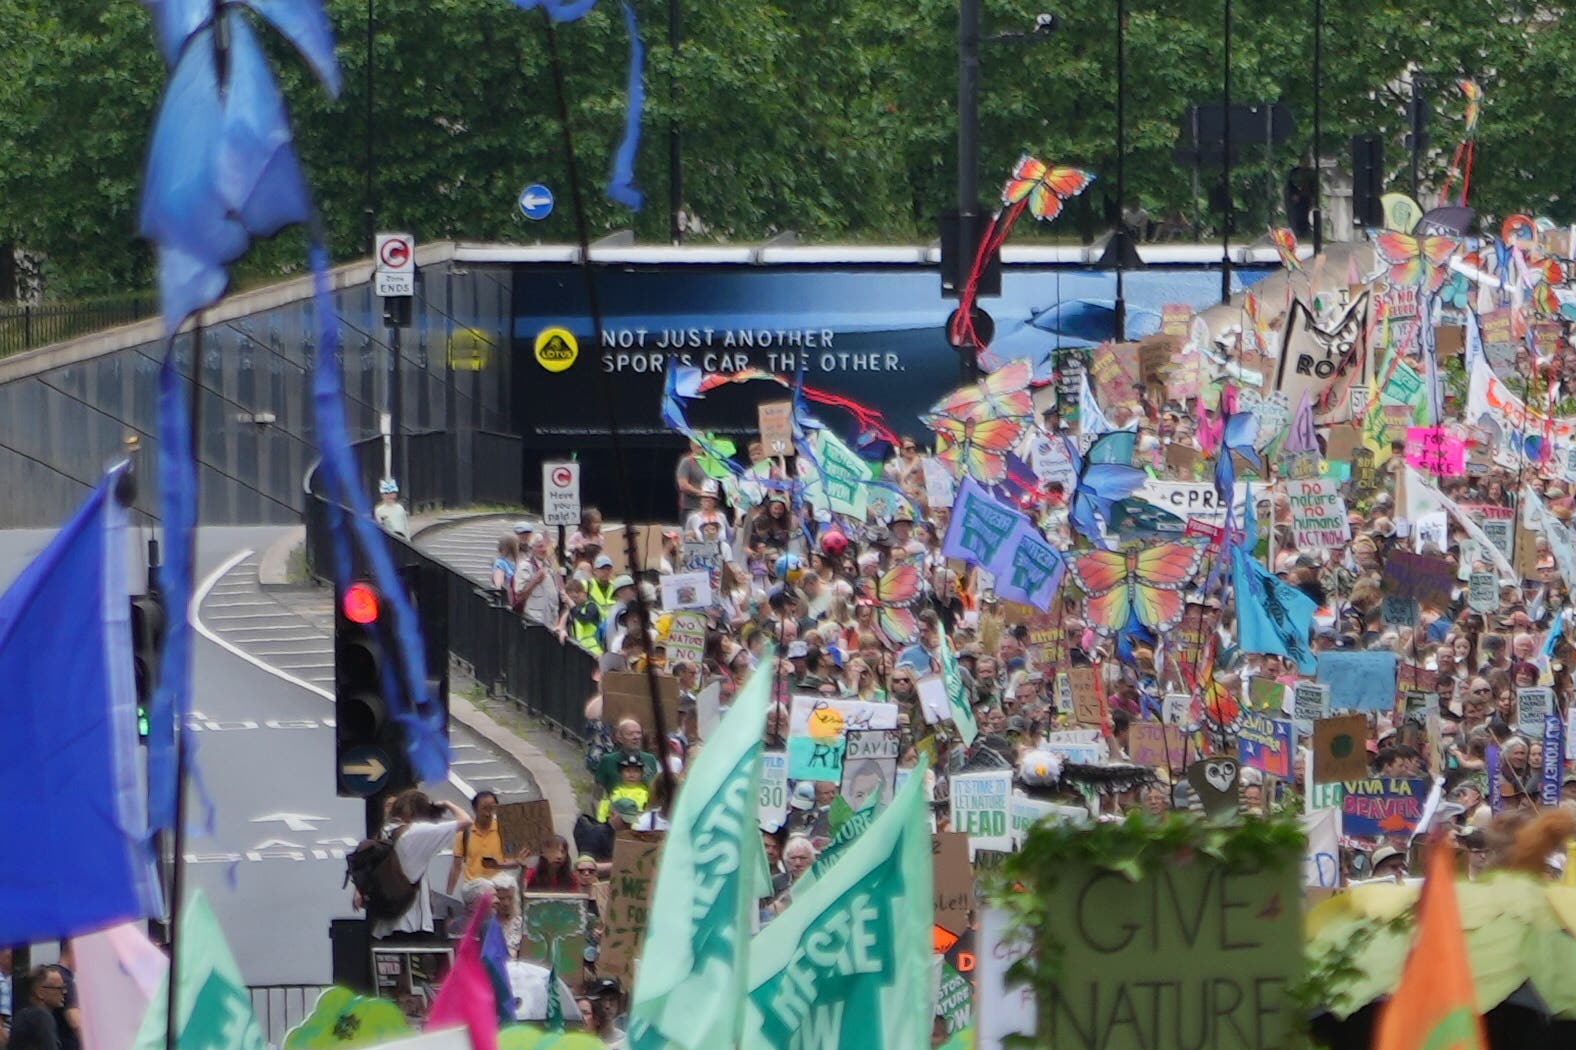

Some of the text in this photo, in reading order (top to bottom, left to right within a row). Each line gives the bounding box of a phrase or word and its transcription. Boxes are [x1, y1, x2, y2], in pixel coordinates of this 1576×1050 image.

[380, 283, 410, 294] ENDS
[601, 328, 835, 348] NOT JUST ANOTHER
[541, 350, 574, 360] LOTUS
[601, 352, 692, 373] SPORS
[768, 352, 810, 373] THE
[820, 352, 906, 373] OTHER.
[1419, 461, 1453, 473] SAKE
[550, 491, 574, 501] Have
[1301, 482, 1322, 495] no
[553, 502, 571, 511] you
[1290, 493, 1337, 506] nature
[1304, 506, 1325, 518] no
[1298, 529, 1345, 547] ACT NOW
[676, 619, 696, 631] NO
[675, 648, 696, 660] NO
[808, 743, 841, 770] RI
[849, 740, 900, 757] DAVID
[1544, 741, 1559, 783] MONEY
[1344, 779, 1412, 796] VIVA LA
[1543, 784, 1559, 807] OUT
[760, 785, 783, 808] 30
[970, 793, 1006, 809] NATURE
[1343, 795, 1422, 820] BEAVER
[956, 809, 1007, 838] LEAD
[620, 875, 647, 898] WE
[628, 904, 648, 923] FO
[1076, 866, 1263, 954] GIVE
[934, 989, 970, 1016] ATURE
